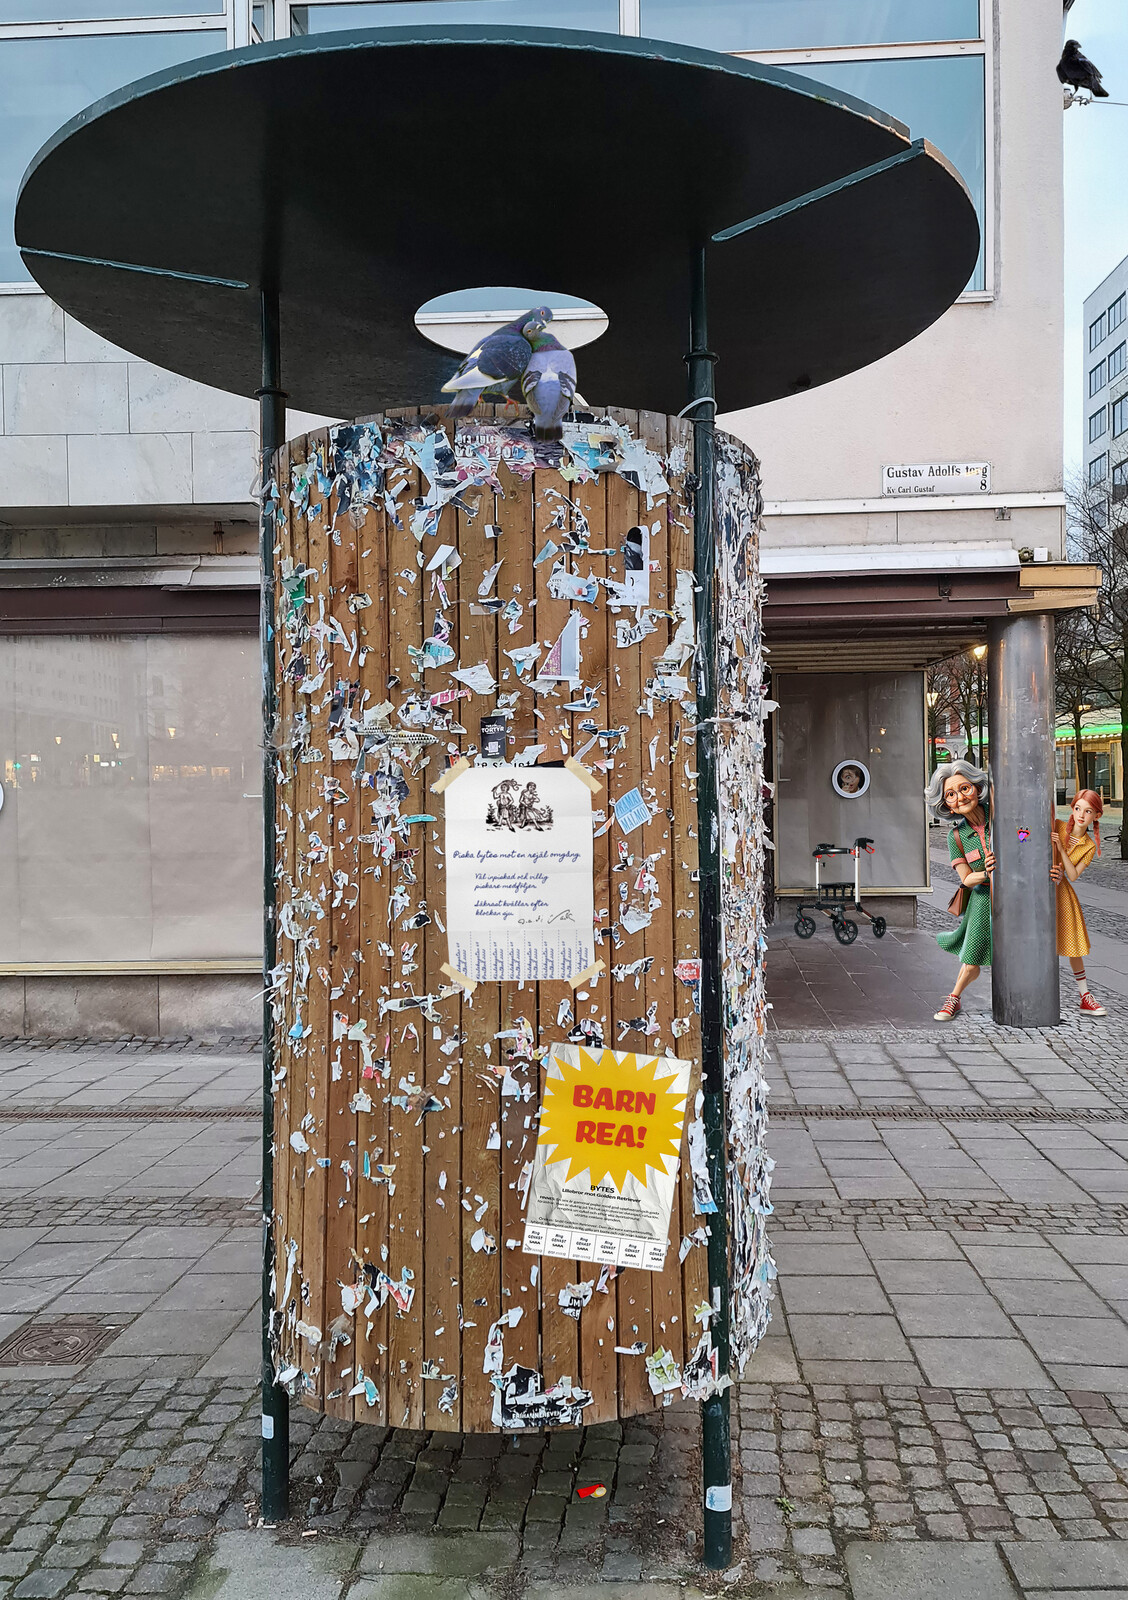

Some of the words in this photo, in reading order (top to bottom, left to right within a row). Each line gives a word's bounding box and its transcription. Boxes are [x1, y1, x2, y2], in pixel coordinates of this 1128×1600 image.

[886, 467, 924, 478] Gustav
[928, 465, 961, 477] Adolfs
[980, 479, 987, 490] 8
[453, 850, 474, 858] Piska
[477, 850, 498, 863] bytes
[500, 850, 516, 858] mot
[527, 851, 548, 863] rejäl
[529, 873, 549, 884] villig
[573, 1084, 656, 1115] BARN
[576, 1120, 647, 1148] REA!
[590, 1185, 615, 1194] BYTES
